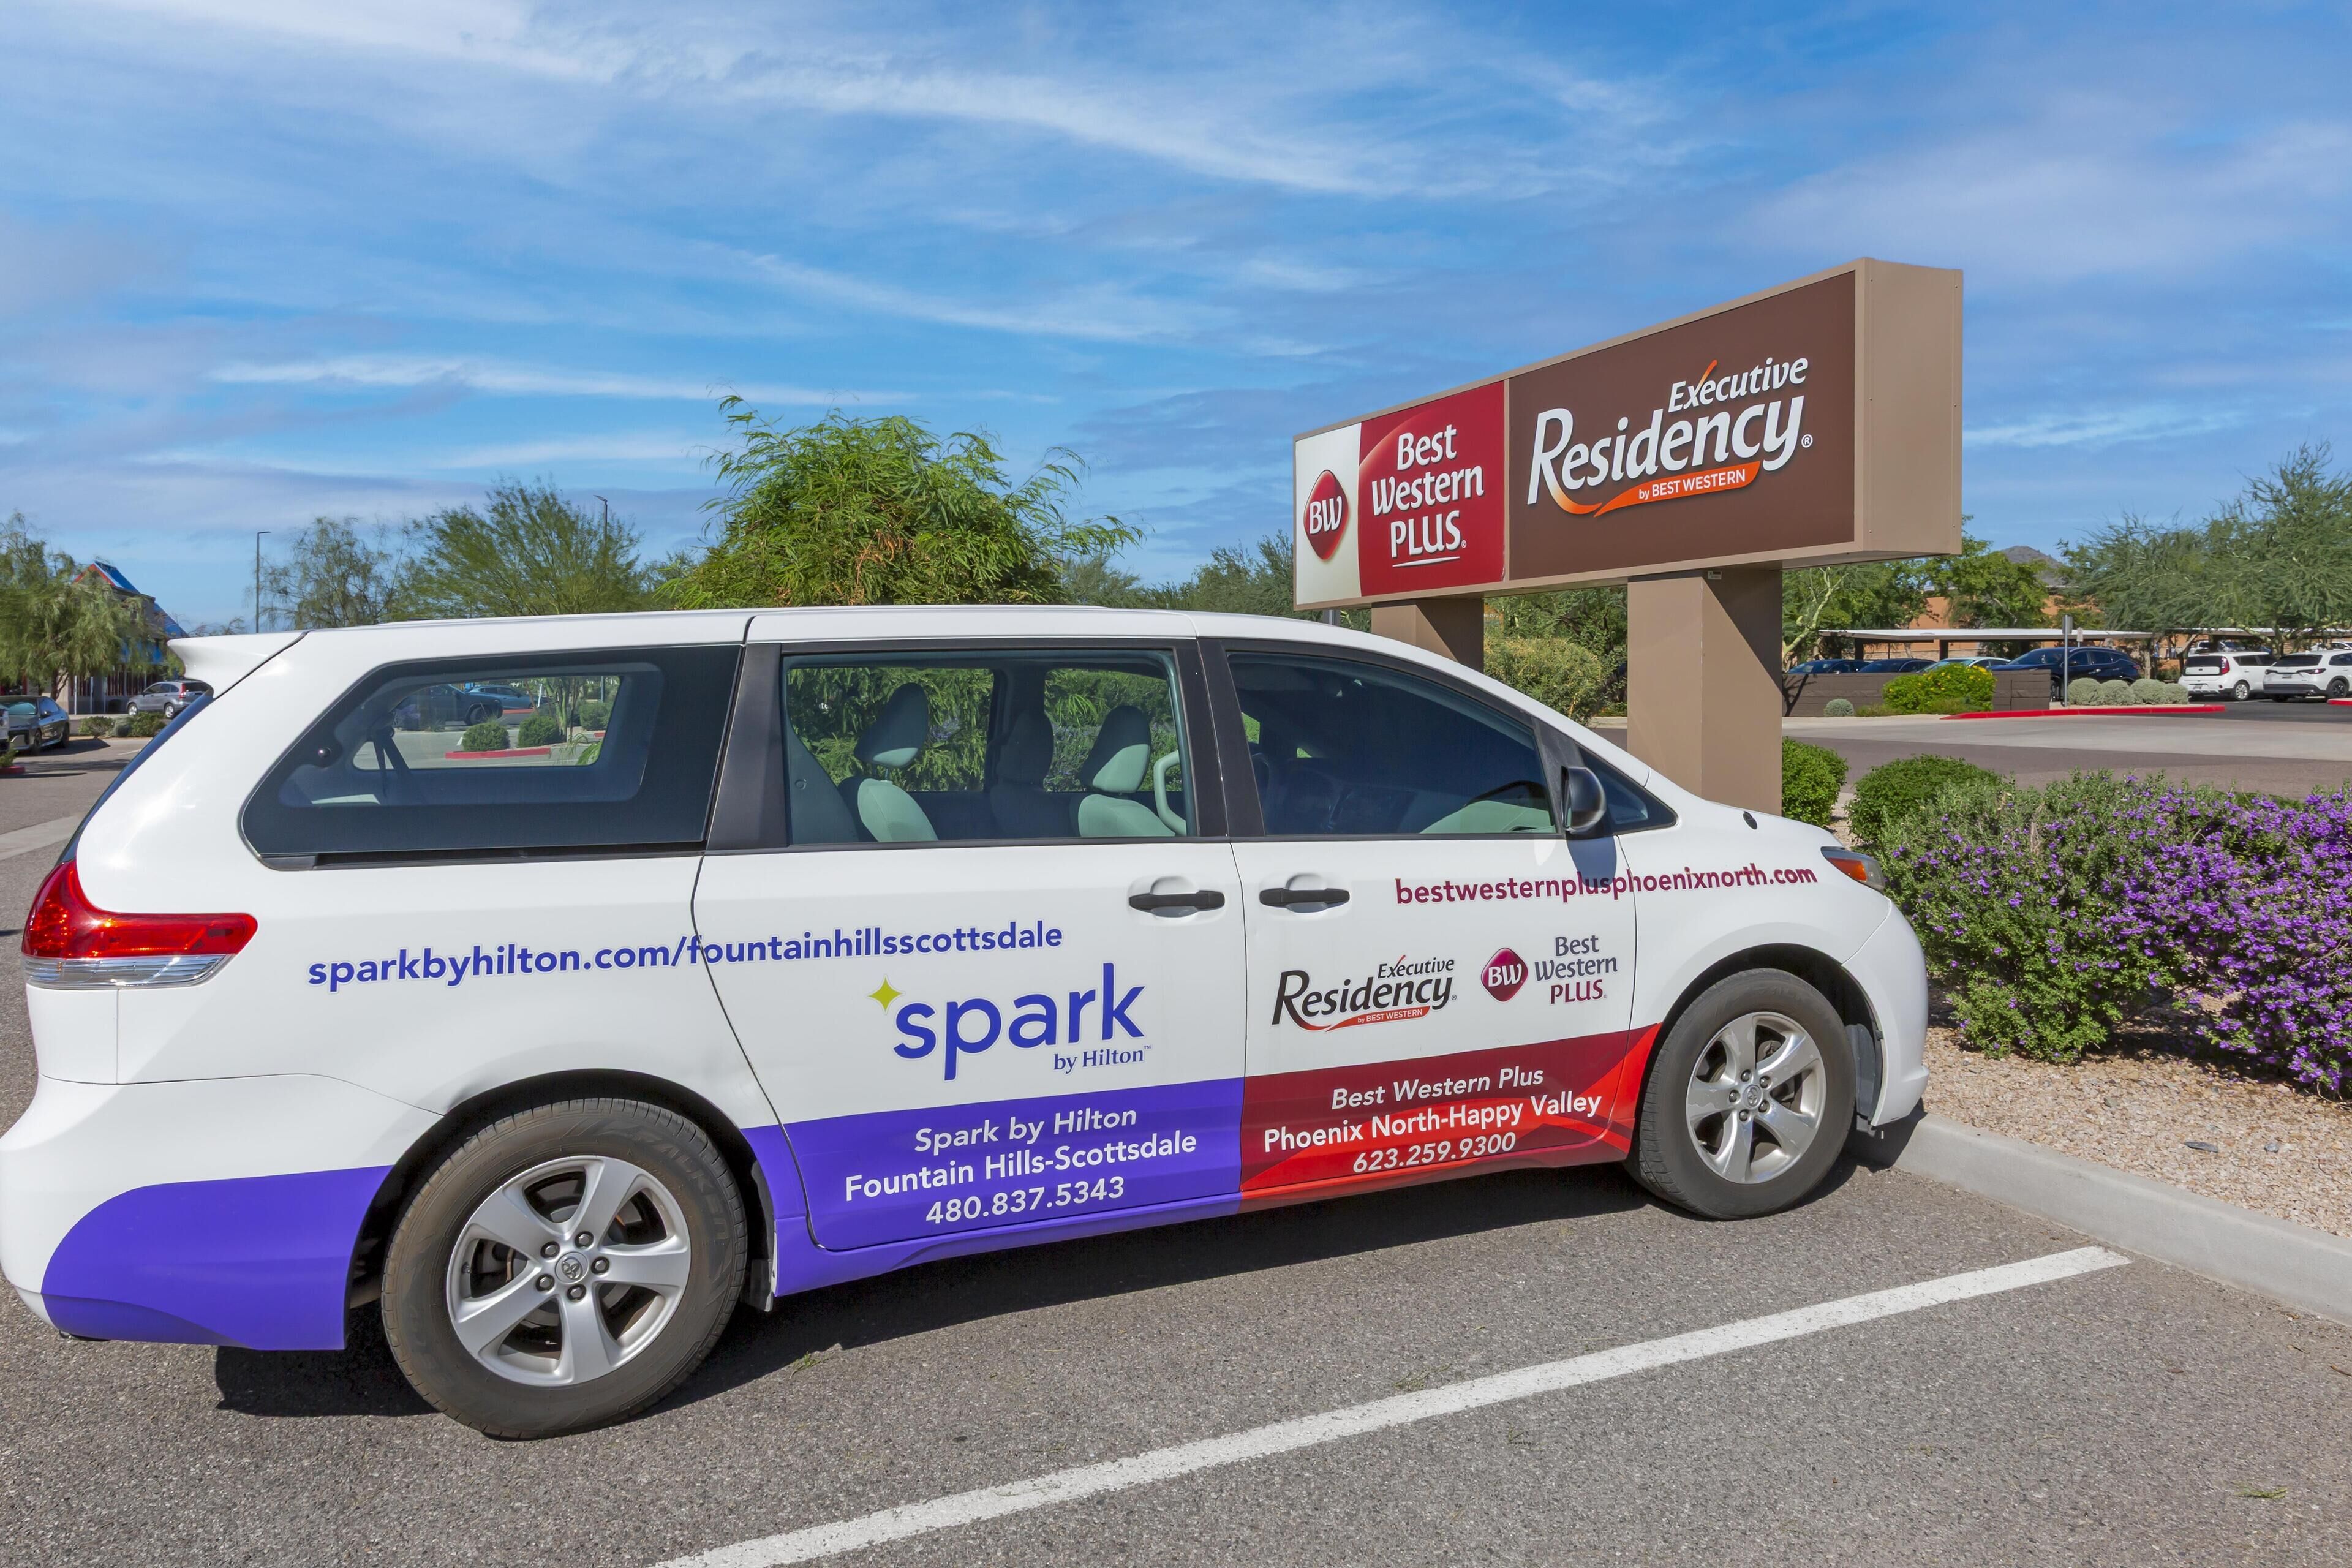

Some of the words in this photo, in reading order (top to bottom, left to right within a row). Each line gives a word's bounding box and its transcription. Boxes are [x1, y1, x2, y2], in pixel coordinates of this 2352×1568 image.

[1667, 356, 1809, 413] Executive
[1397, 424, 1457, 470] Best
[1371, 466, 1484, 516] Western
[1638, 489, 1650, 500] by
[1652, 480, 1681, 497] BEST
[1683, 469, 1746, 491] WESTERN
[1310, 496, 1343, 535] BW
[1395, 863, 1818, 905] bestwesternplusphoenixnorth.com
[308, 920, 1063, 993] sparkbyhilton.com/fountainhillsscottsdale
[1378, 955, 1455, 979] Executive
[1555, 935, 1599, 957] Best
[1488, 963, 1522, 987] BW
[1534, 957, 1618, 981] Western
[893, 962, 1147, 1081] spark
[1366, 1013, 1385, 1022] BEST
[1385, 1009, 1423, 1020] WESTERN
[1054, 1054, 1078, 1074] by
[1332, 1086, 1386, 1110] Best
[1393, 1076, 1491, 1102] Western
[1498, 1066, 1544, 1089] Plus
[914, 1120, 1000, 1155] Spark
[1009, 1117, 1044, 1145] by
[1054, 1107, 1137, 1134] Hilton
[1264, 1120, 1364, 1153] Phoenix
[1371, 1102, 1524, 1139] North-Happy
[1530, 1090, 1602, 1117] Valley
[845, 1160, 974, 1202] Fountain
[985, 1130, 1197, 1180] Hills-Scottsdale
[1352, 1132, 1516, 1173] 623.259.9300
[925, 1176, 1125, 1224] 480.837.5343
